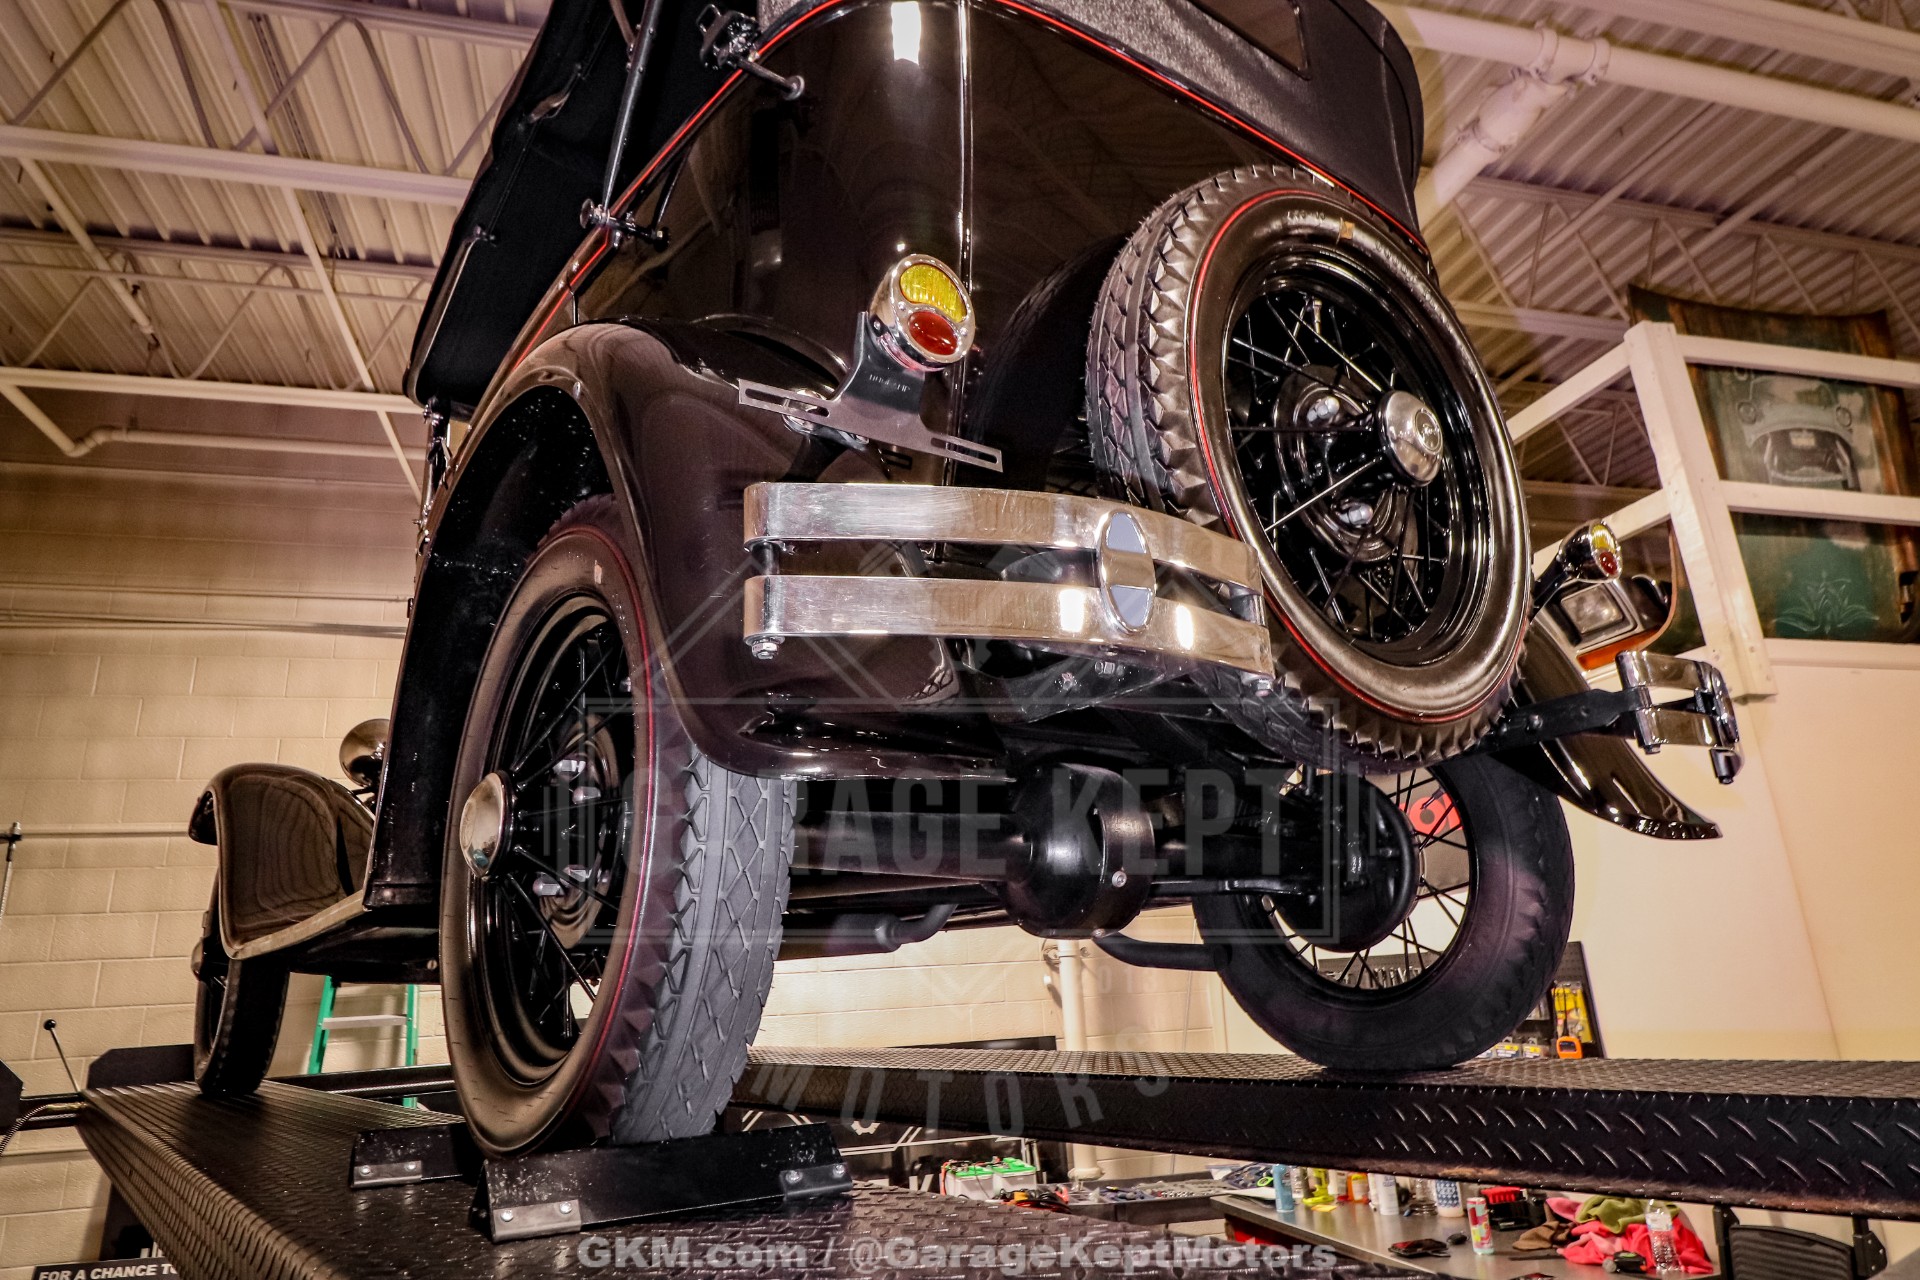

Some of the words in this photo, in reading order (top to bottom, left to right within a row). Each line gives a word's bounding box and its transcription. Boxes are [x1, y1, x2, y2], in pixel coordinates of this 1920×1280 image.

[38, 1271, 71, 1280] FOR
[74, 1270, 87, 1280] A
[90, 1265, 158, 1279] CHANCE
